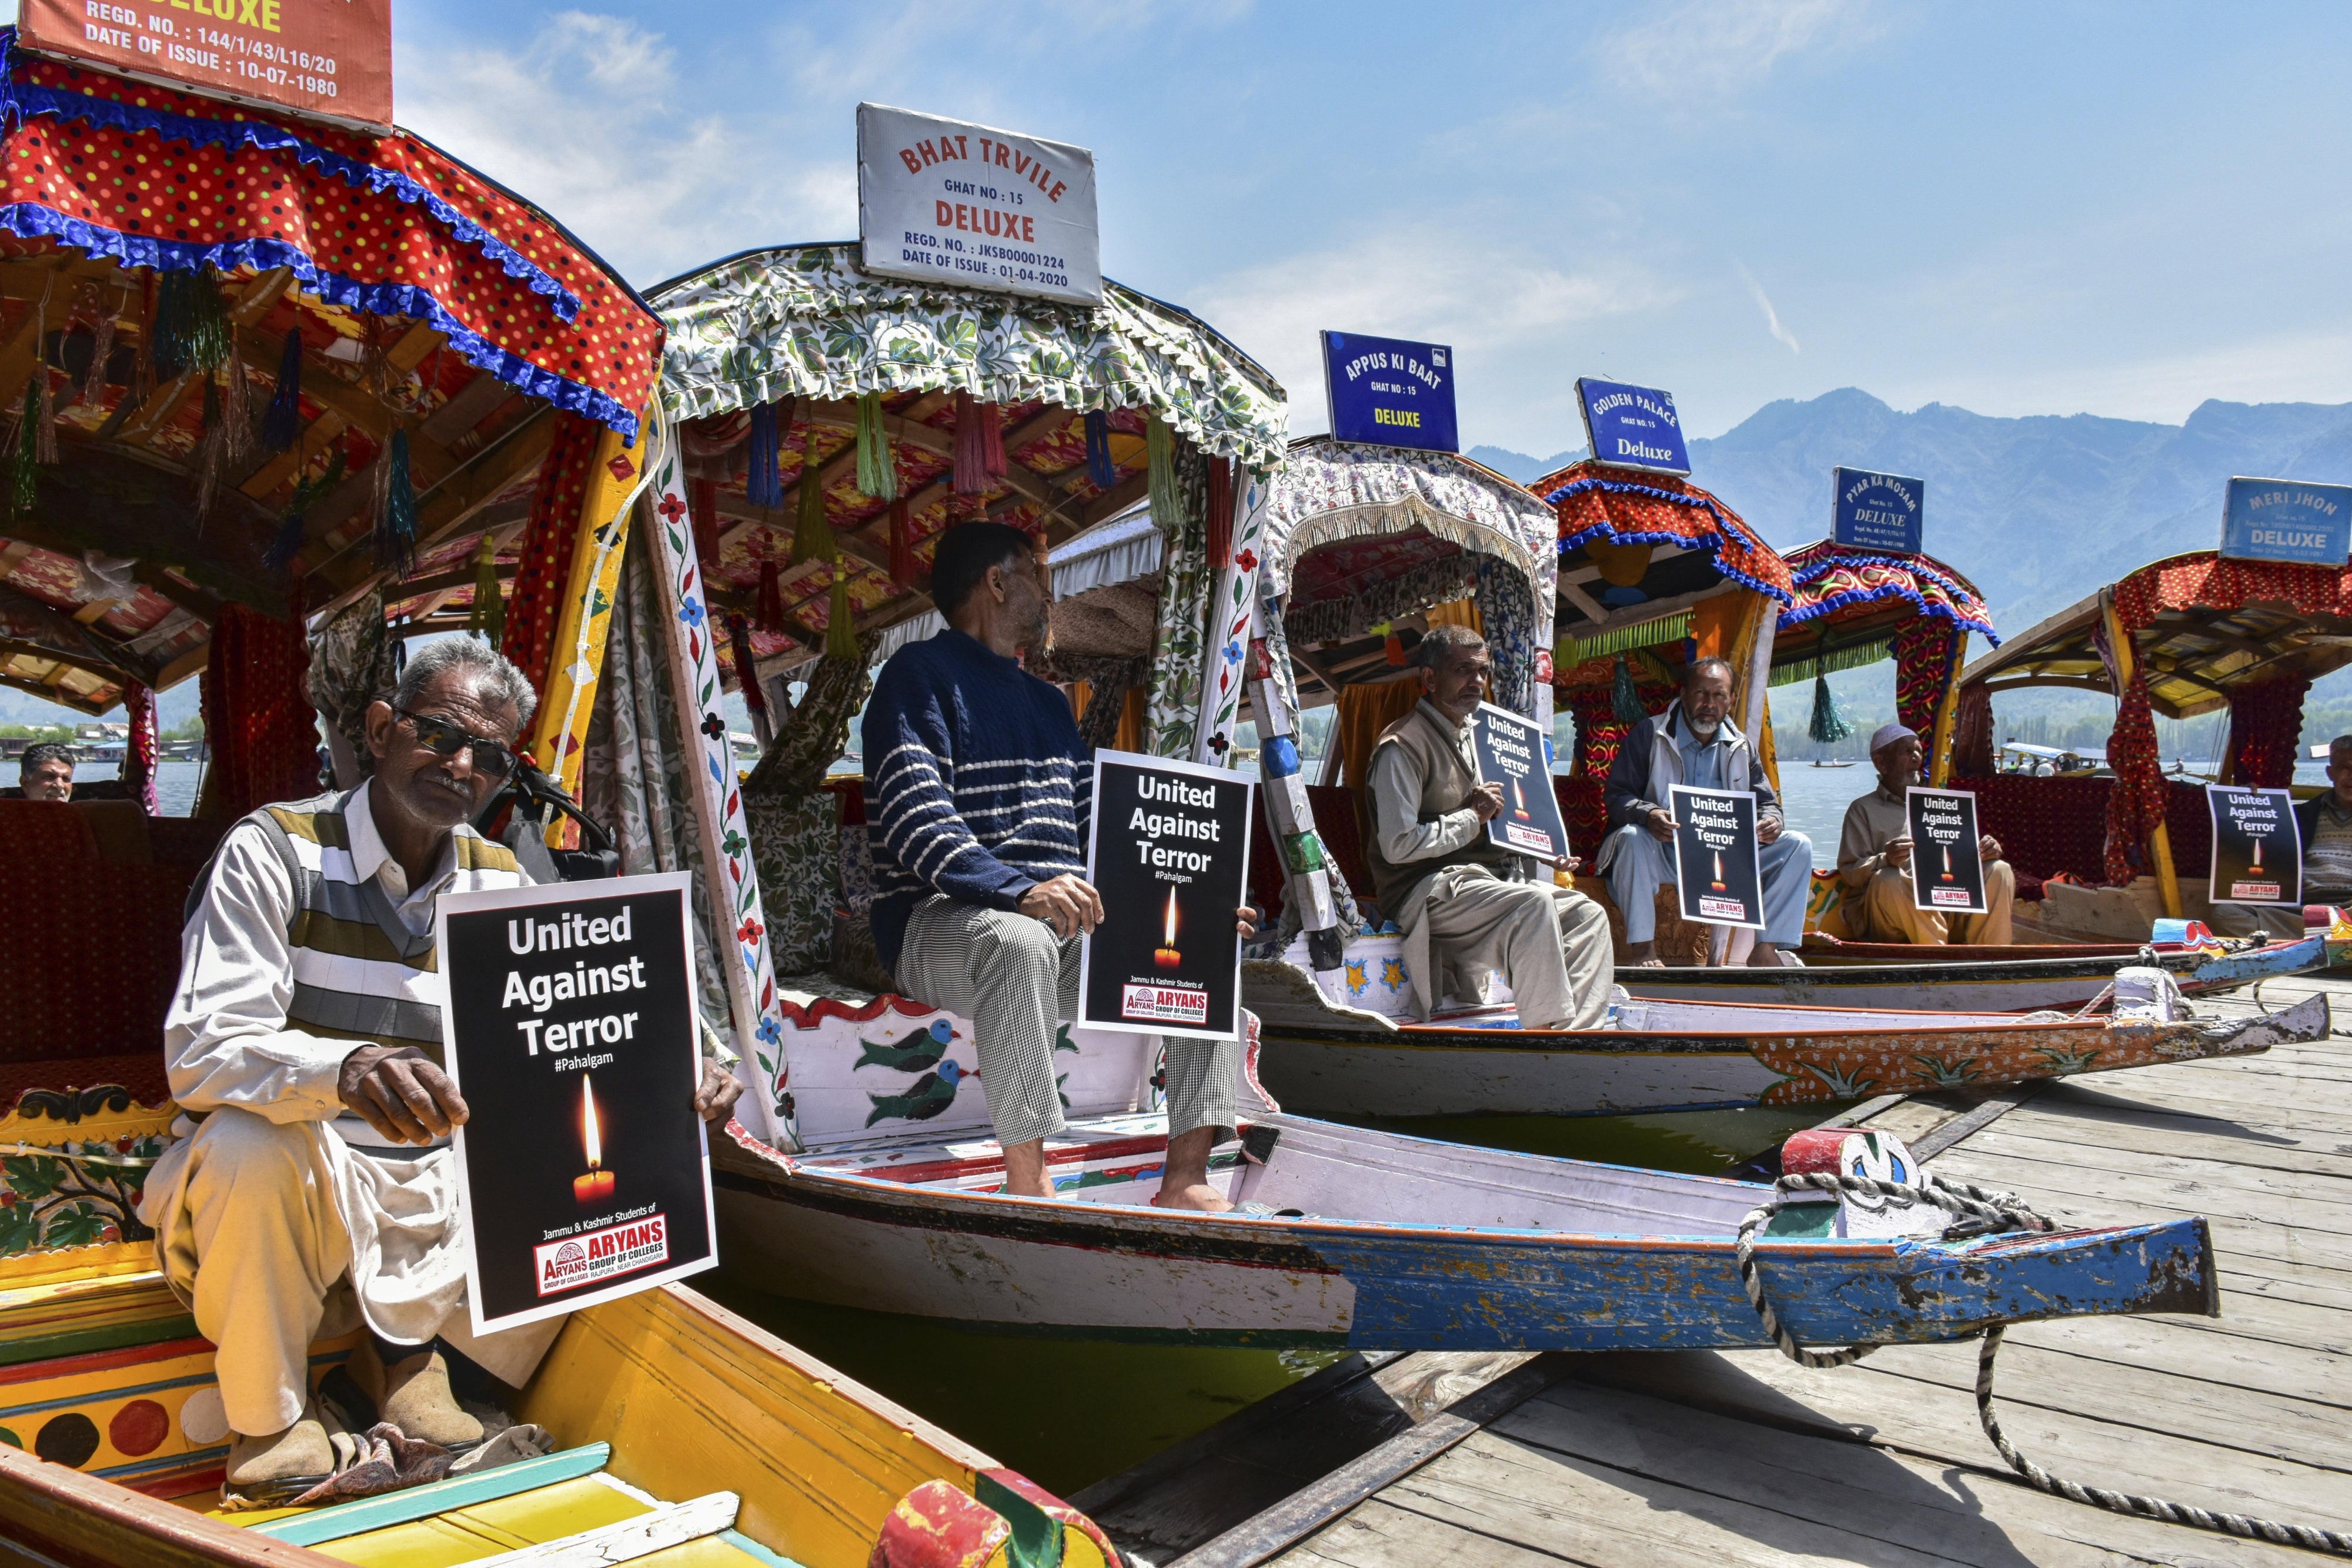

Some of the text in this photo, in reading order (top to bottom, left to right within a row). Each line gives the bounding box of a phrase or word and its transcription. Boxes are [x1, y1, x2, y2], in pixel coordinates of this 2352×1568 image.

[147, 0, 280, 33] LUXE
[86, 1, 142, 27] REGD.
[149, 15, 179, 38] NO.
[198, 27, 336, 75] 144/1/43/L16/20
[86, 24, 131, 49] DATE
[138, 36, 161, 54] OF
[168, 42, 219, 72] ISSUE
[238, 60, 337, 98] 10-07-1980
[899, 135, 1067, 203] BHAT TRVILE
[944, 179, 975, 196] GHAT
[980, 186, 997, 200] NO
[1010, 191, 1023, 205] 15
[936, 199, 1035, 243] DELUXE
[904, 232, 940, 249] REGD.
[945, 238, 966, 253] NO.
[978, 244, 1065, 270] JKSB00001224
[903, 249, 932, 265] DATE
[936, 253, 951, 268] OF
[956, 258, 988, 275] ISSUE
[1000, 265, 1068, 287] 01-04-2020
[1345, 353, 1442, 390] APPUS KI BAAT
[1371, 381, 1389, 392] GHAT
[1391, 384, 1401, 393] NO
[1408, 386, 1416, 395] 15
[1375, 407, 1421, 428] DELUXE
[1593, 393, 1677, 427] GOLDEN PALACE
[1621, 416, 1635, 426] GHAT
[1637, 419, 1647, 427] NO.
[1618, 438, 1672, 461] Deluxe
[1846, 475, 1917, 513] PYAR KA MOSAM
[2249, 491, 2338, 516] MERI JHON
[1855, 509, 1906, 527] DELUXE
[2251, 529, 2327, 549] DELUXE
[1488, 714, 1525, 741] United
[1487, 733, 1531, 759] Against
[1492, 750, 1529, 774] Terror
[1138, 775, 1215, 809] United
[2228, 794, 2271, 806] United
[1690, 797, 1733, 813] United
[1923, 797, 1958, 811] United
[2229, 807, 2278, 820] Against
[1129, 807, 1220, 842] Against
[1690, 812, 1739, 830] Against
[1922, 811, 1963, 825] Against
[2235, 820, 2276, 832] Terror
[1522, 831, 1549, 844] ARYANS
[1695, 828, 1735, 845] Terror
[1926, 826, 1960, 840] Terror
[1136, 840, 1211, 872] Terror
[1155, 870, 1192, 884] #Pahalgam
[1716, 902, 1742, 913] ARYANS
[508, 905, 632, 955] United
[502, 955, 647, 1013] Against
[1130, 975, 1150, 984] Jammu
[1156, 978, 1176, 987] Kashmir
[1177, 979, 1197, 988] Students
[1126, 995, 1154, 1010] ARYANS
[1155, 991, 1205, 1009] ARYANS
[1181, 1008, 1204, 1016] COLLEGES
[518, 1011, 639, 1057] Terror
[555, 1053, 613, 1072] #Pahalgam
[543, 1202, 656, 1241] Jammu & Kashmir Students of
[589, 1221, 663, 1261] ARYANS
[589, 1242, 663, 1271] GROUP OF COLLEGES
[590, 1252, 664, 1278] RAJPURA, NEAR CHANDIGARH
[544, 1259, 587, 1281] ARYANS
[544, 1280, 560, 1289] GROUP
[567, 1272, 589, 1283] COLLEGES
